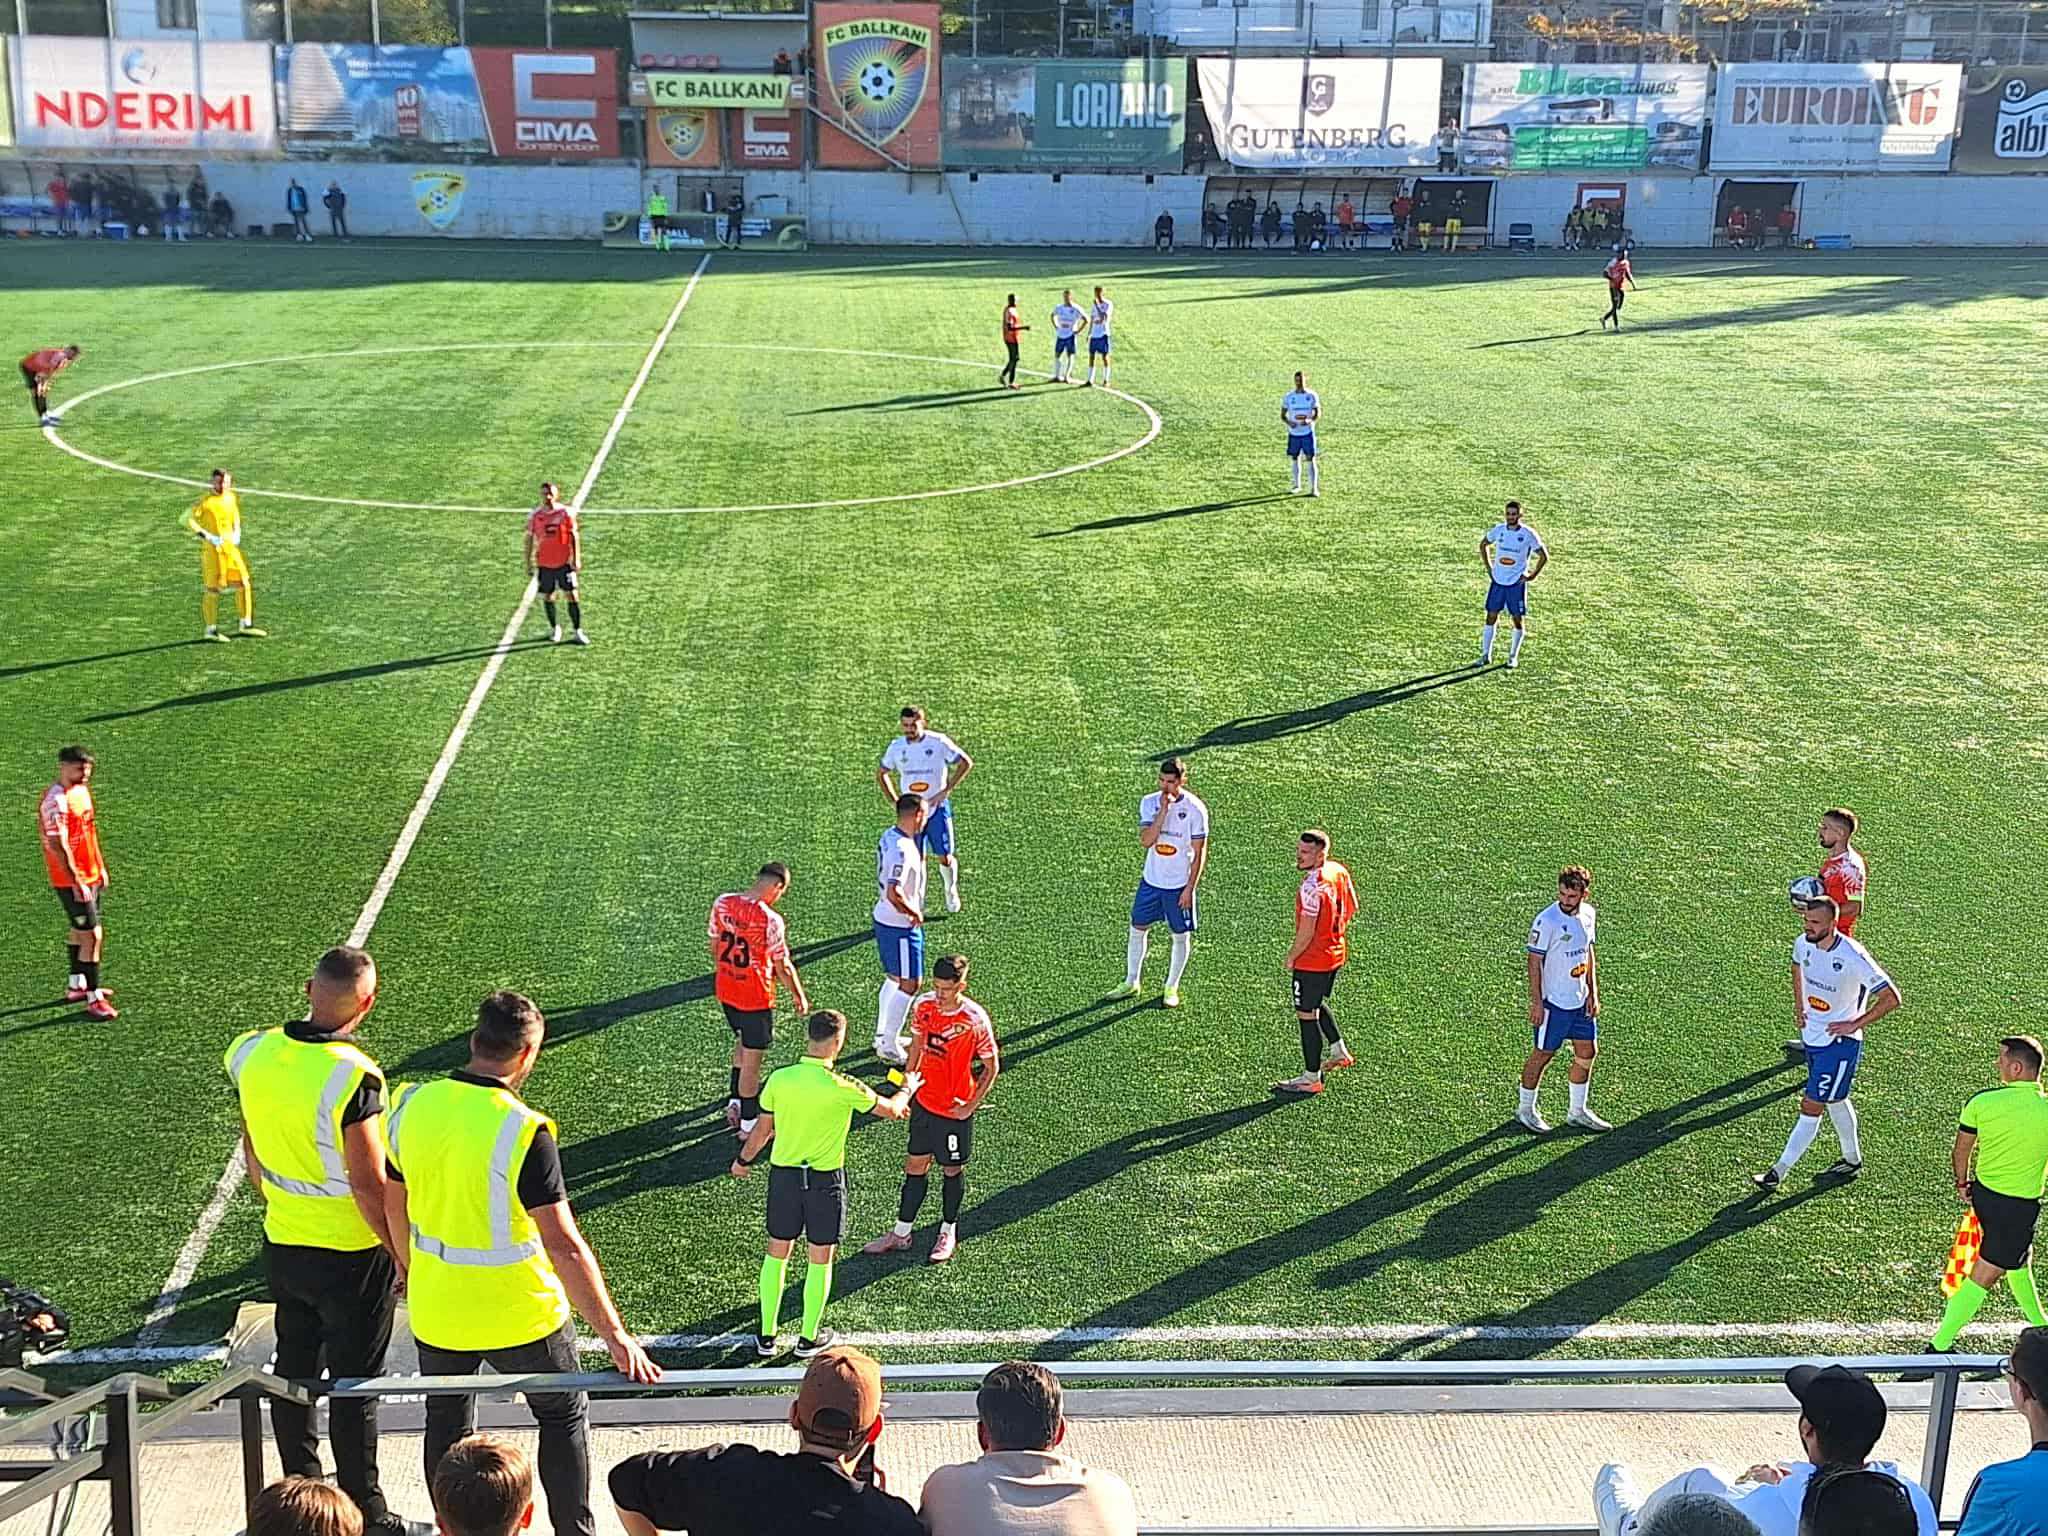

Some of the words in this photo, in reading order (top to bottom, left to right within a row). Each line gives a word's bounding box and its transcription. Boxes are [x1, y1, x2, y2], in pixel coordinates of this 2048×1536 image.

[826, 28, 845, 43] FC
[849, 22, 928, 43] BALLKANI
[655, 80, 677, 98] FC
[685, 81, 782, 99] BALLKANI
[35, 91, 253, 131] NDERIMI
[1055, 81, 1174, 129] LORIANO
[515, 121, 598, 142] CIMA
[1229, 123, 1406, 150] GUTENBERG
[2000, 113, 2048, 152] albi
[744, 144, 789, 156] CIMA
[721, 930, 749, 968] 23
[1818, 1074, 1831, 1090] 2
